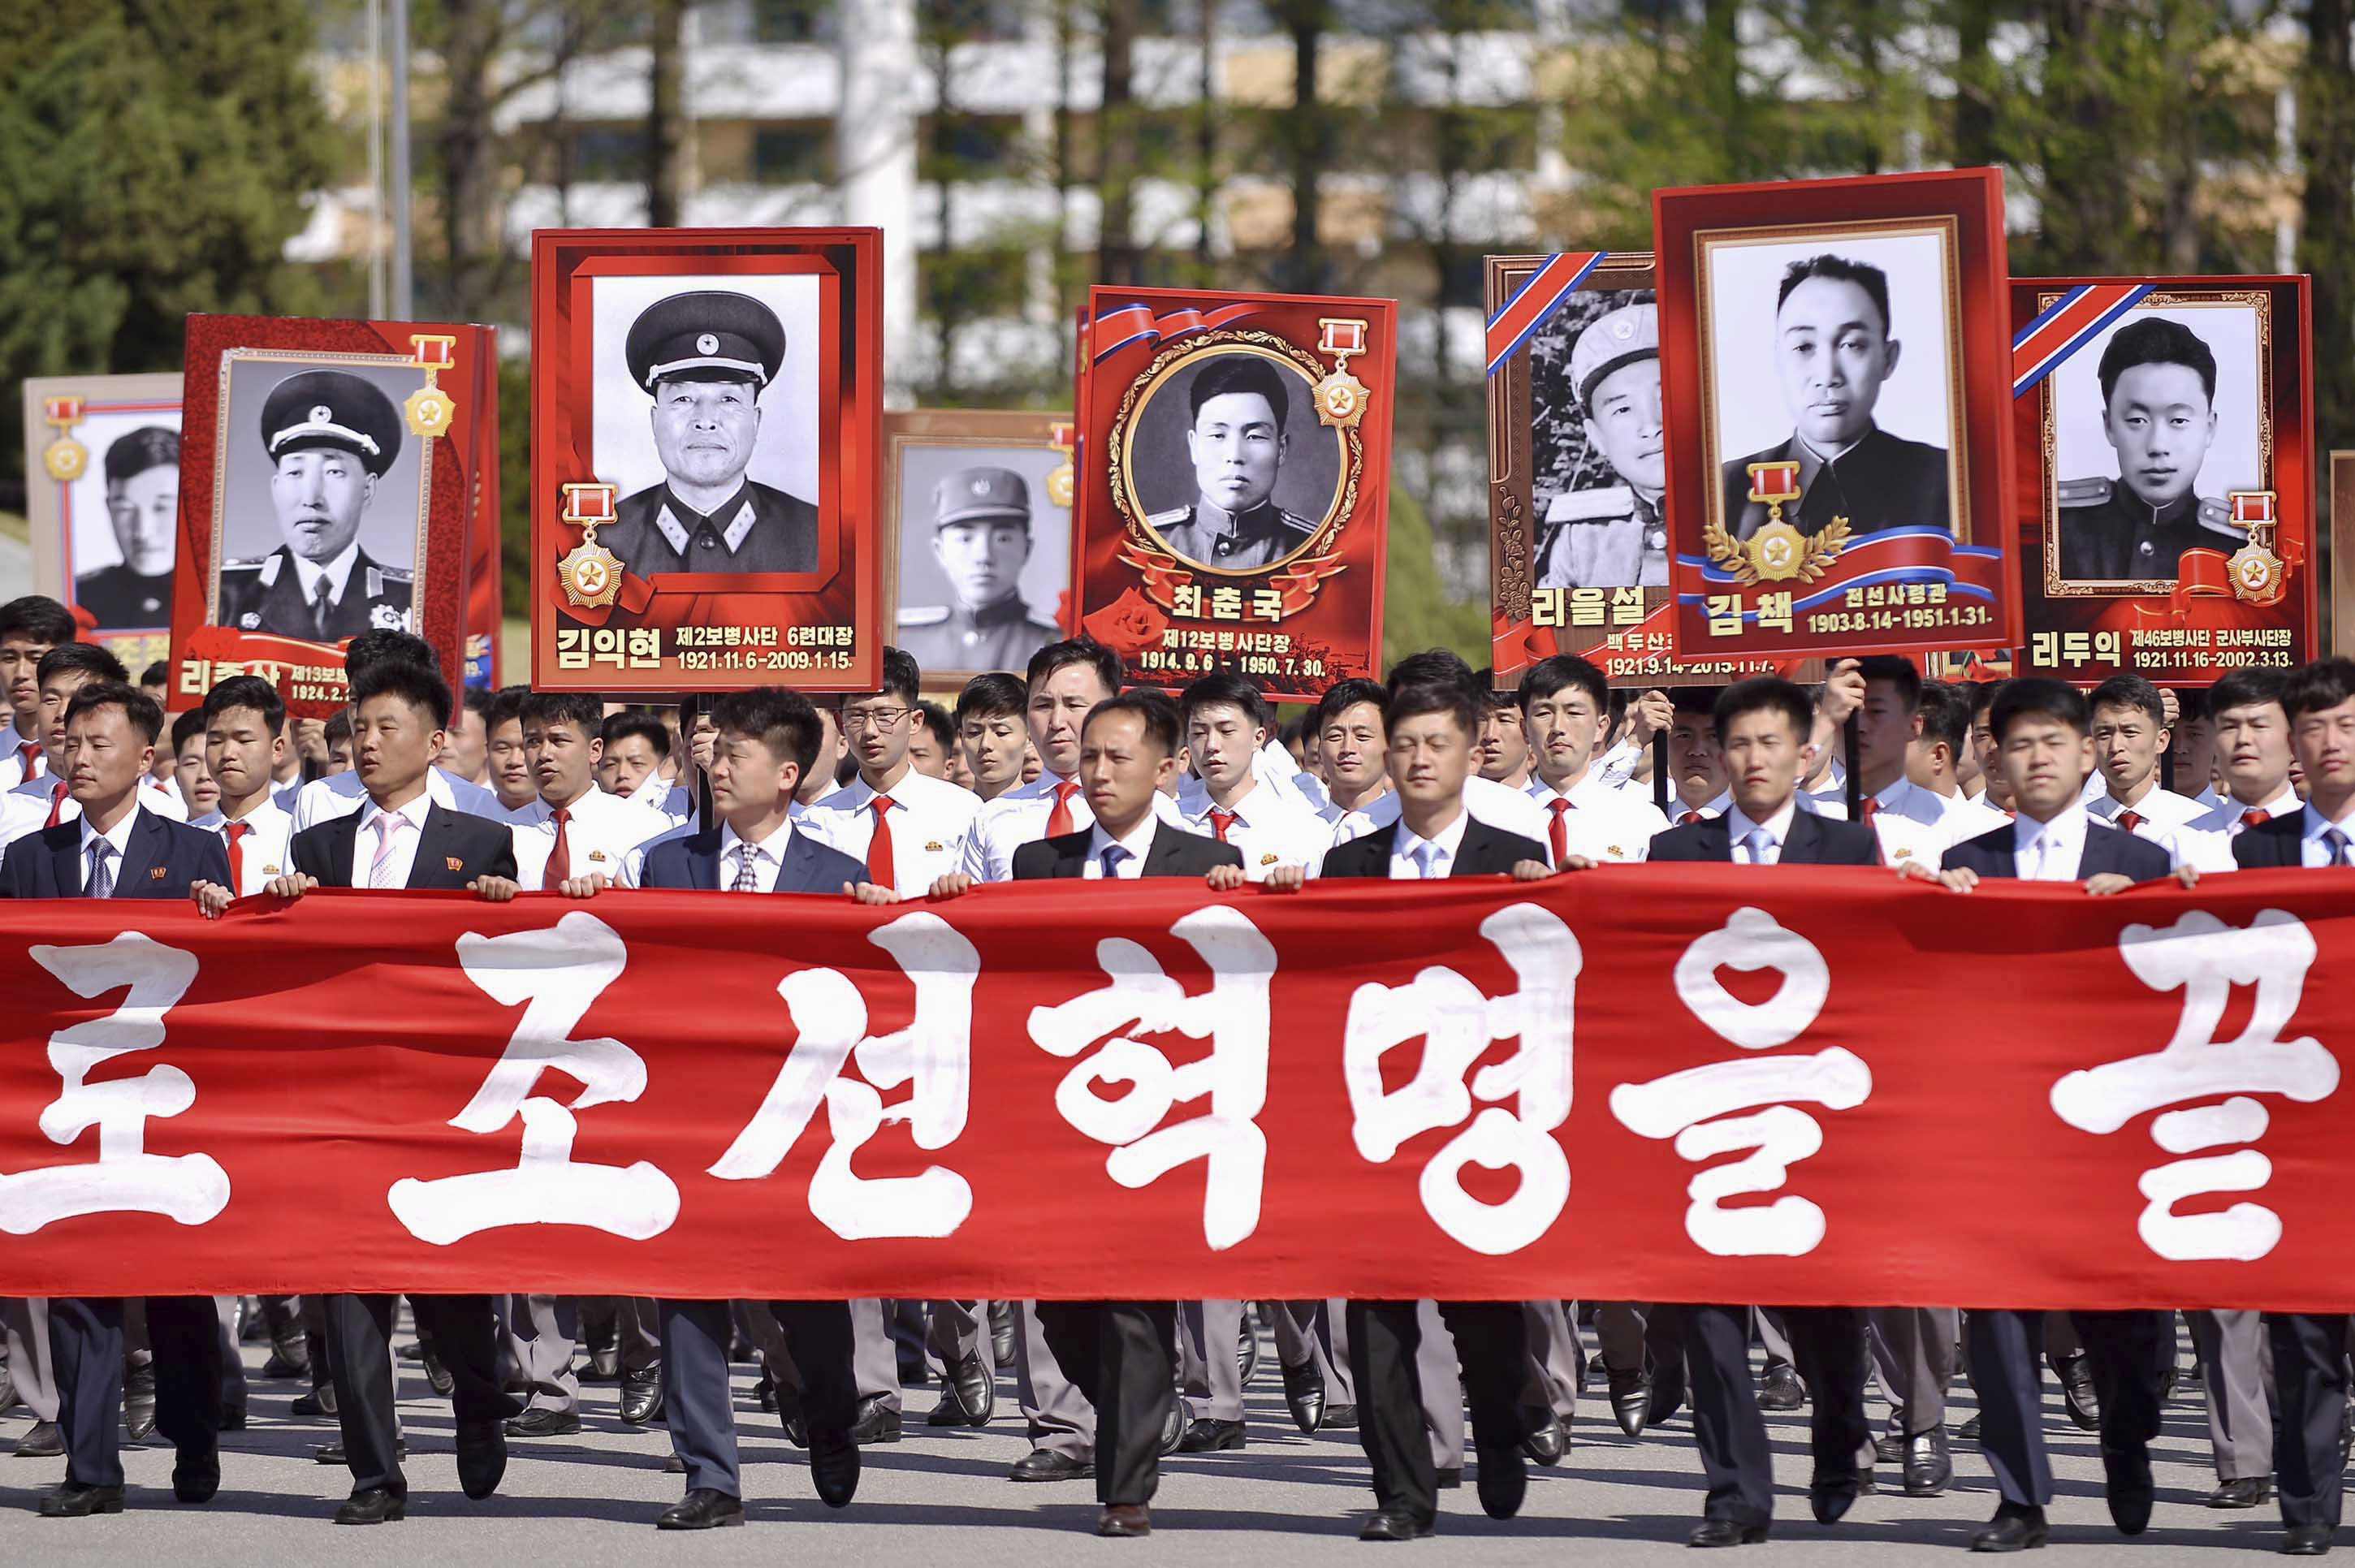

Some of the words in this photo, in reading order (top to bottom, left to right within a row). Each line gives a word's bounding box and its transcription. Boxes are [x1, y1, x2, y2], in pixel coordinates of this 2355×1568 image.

[1532, 585, 1645, 627] 리을설
[1844, 583, 1947, 607] 전선사령관
[1808, 607, 1993, 633] 1903.8.14-1951.1.31.
[557, 628, 660, 669] 김익현
[676, 626, 778, 646] 제2보병사단
[787, 626, 853, 646] 6련대장
[1161, 628, 1290, 653] 제12보병사단장
[2131, 629, 2210, 647] 제46보병사단
[2216, 629, 2292, 647] 군사부사단장
[677, 651, 853, 670] 1921.11.6-2009.1.15.
[2033, 631, 2120, 667] 리두익
[2133, 651, 2293, 667] 1921.11.16-2002.3.13.
[2050, 910, 2340, 1262] 끝
